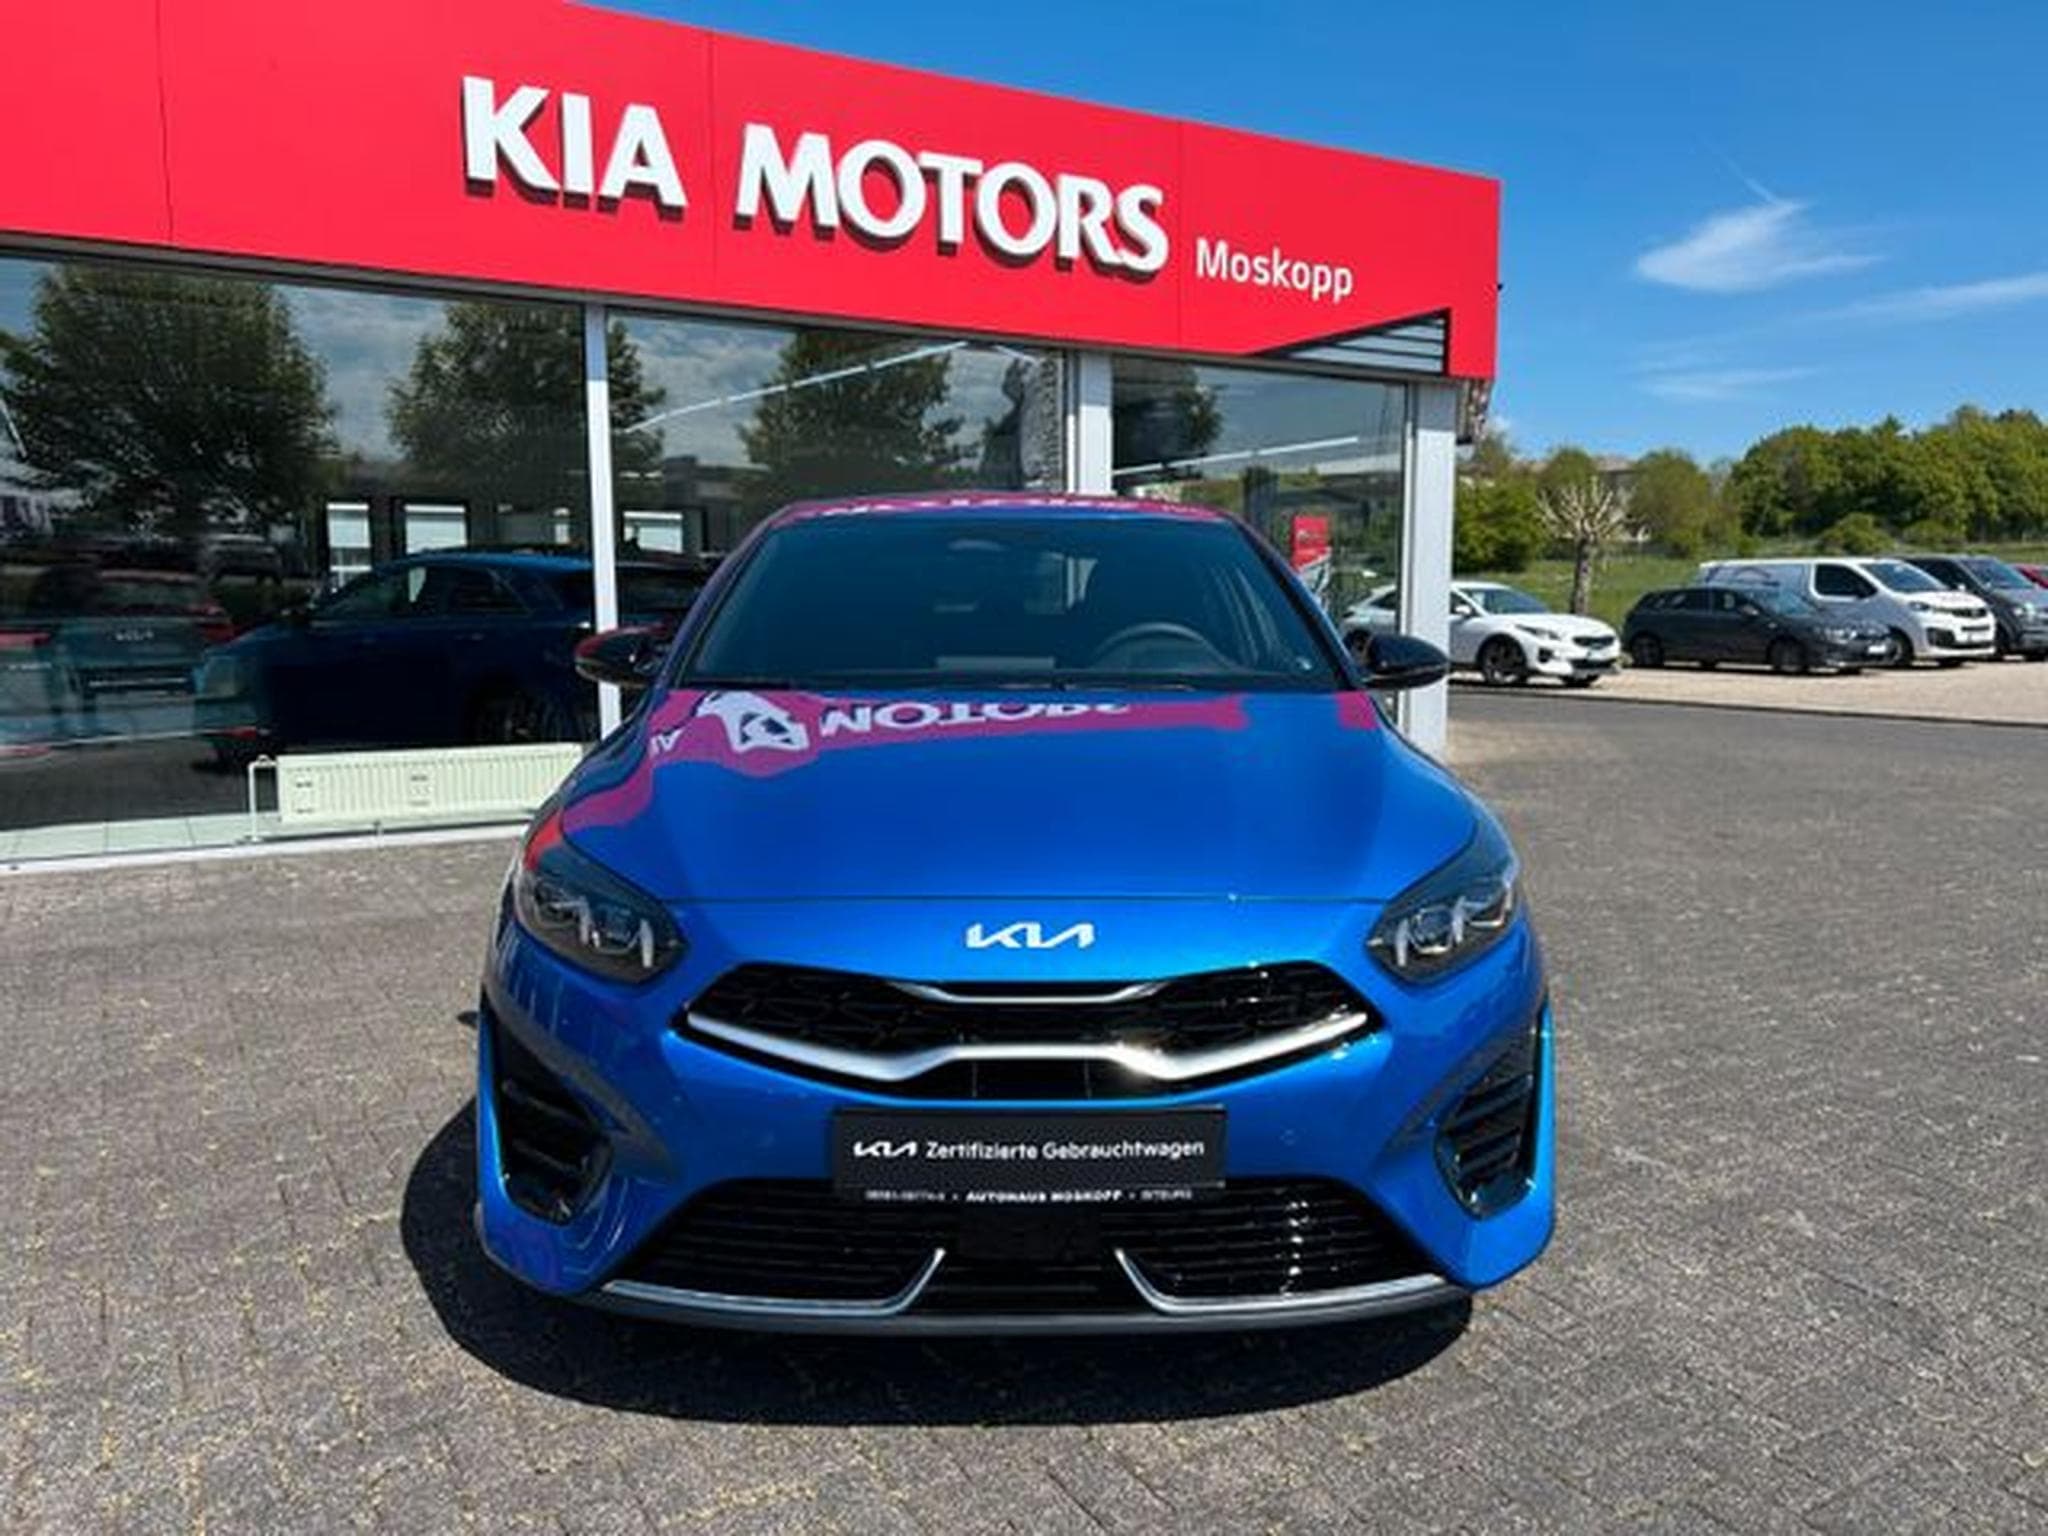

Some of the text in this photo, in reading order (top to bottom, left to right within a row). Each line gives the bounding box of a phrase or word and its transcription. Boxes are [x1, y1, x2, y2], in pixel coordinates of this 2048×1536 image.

[462, 75, 1170, 273] KIA MOTORS
[1196, 237, 1354, 302] Moskopp
[966, 922, 1094, 949] KIA
[925, 1141, 1038, 1160] Zertifizierte
[1041, 1139, 1205, 1160] Gebrauchtwagen
